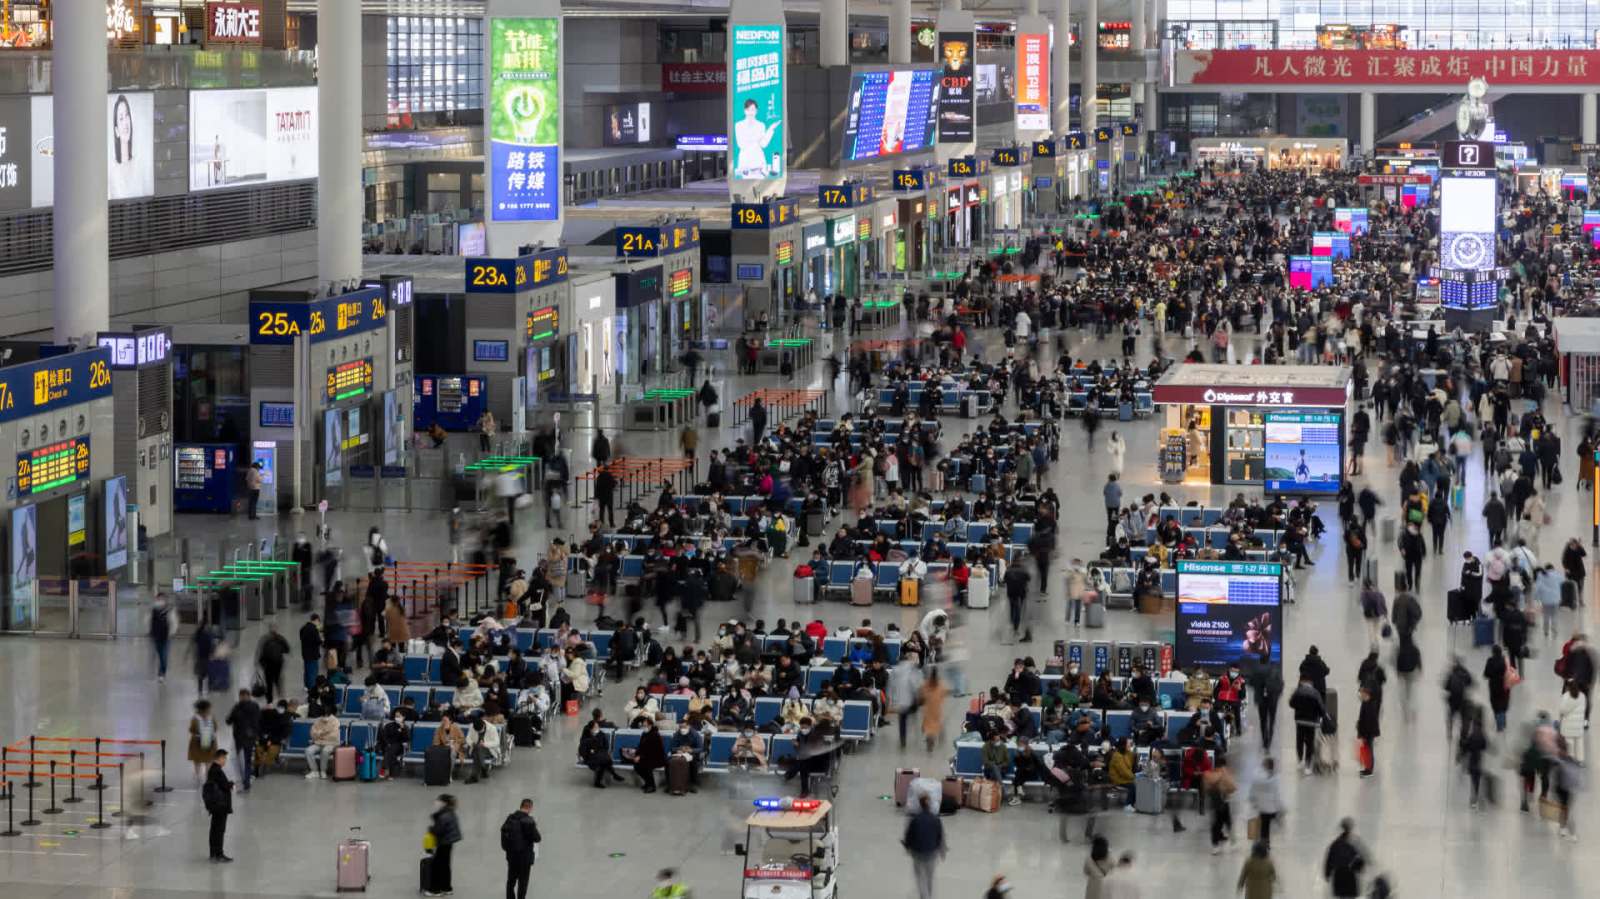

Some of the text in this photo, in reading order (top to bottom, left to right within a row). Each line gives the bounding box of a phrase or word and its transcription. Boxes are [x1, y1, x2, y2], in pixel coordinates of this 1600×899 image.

[215, 7, 260, 38] 永和大王
[736, 30, 779, 40] NEDFON
[1252, 55, 1588, 78] 凡人微光 汇聚成炬 中国力量
[942, 77, 968, 88] CBD
[1038, 144, 1049, 154] 9A
[507, 151, 545, 169] 路铁
[999, 153, 1015, 163] 11A
[953, 163, 971, 174] 13A
[508, 171, 545, 190] 传媒
[898, 174, 918, 186] 15A
[824, 190, 847, 204] 17A
[738, 209, 762, 224] 19A
[623, 233, 653, 250] 21A
[473, 266, 508, 285] 23A
[259, 313, 300, 334] 25A
[310, 311, 326, 335] 25A
[372, 297, 386, 320] 24A
[49, 368, 72, 387] 检票口
[90, 360, 111, 388] 26A
[1256, 391, 1294, 404] 外交官
[1184, 563, 1225, 571] Hisense
